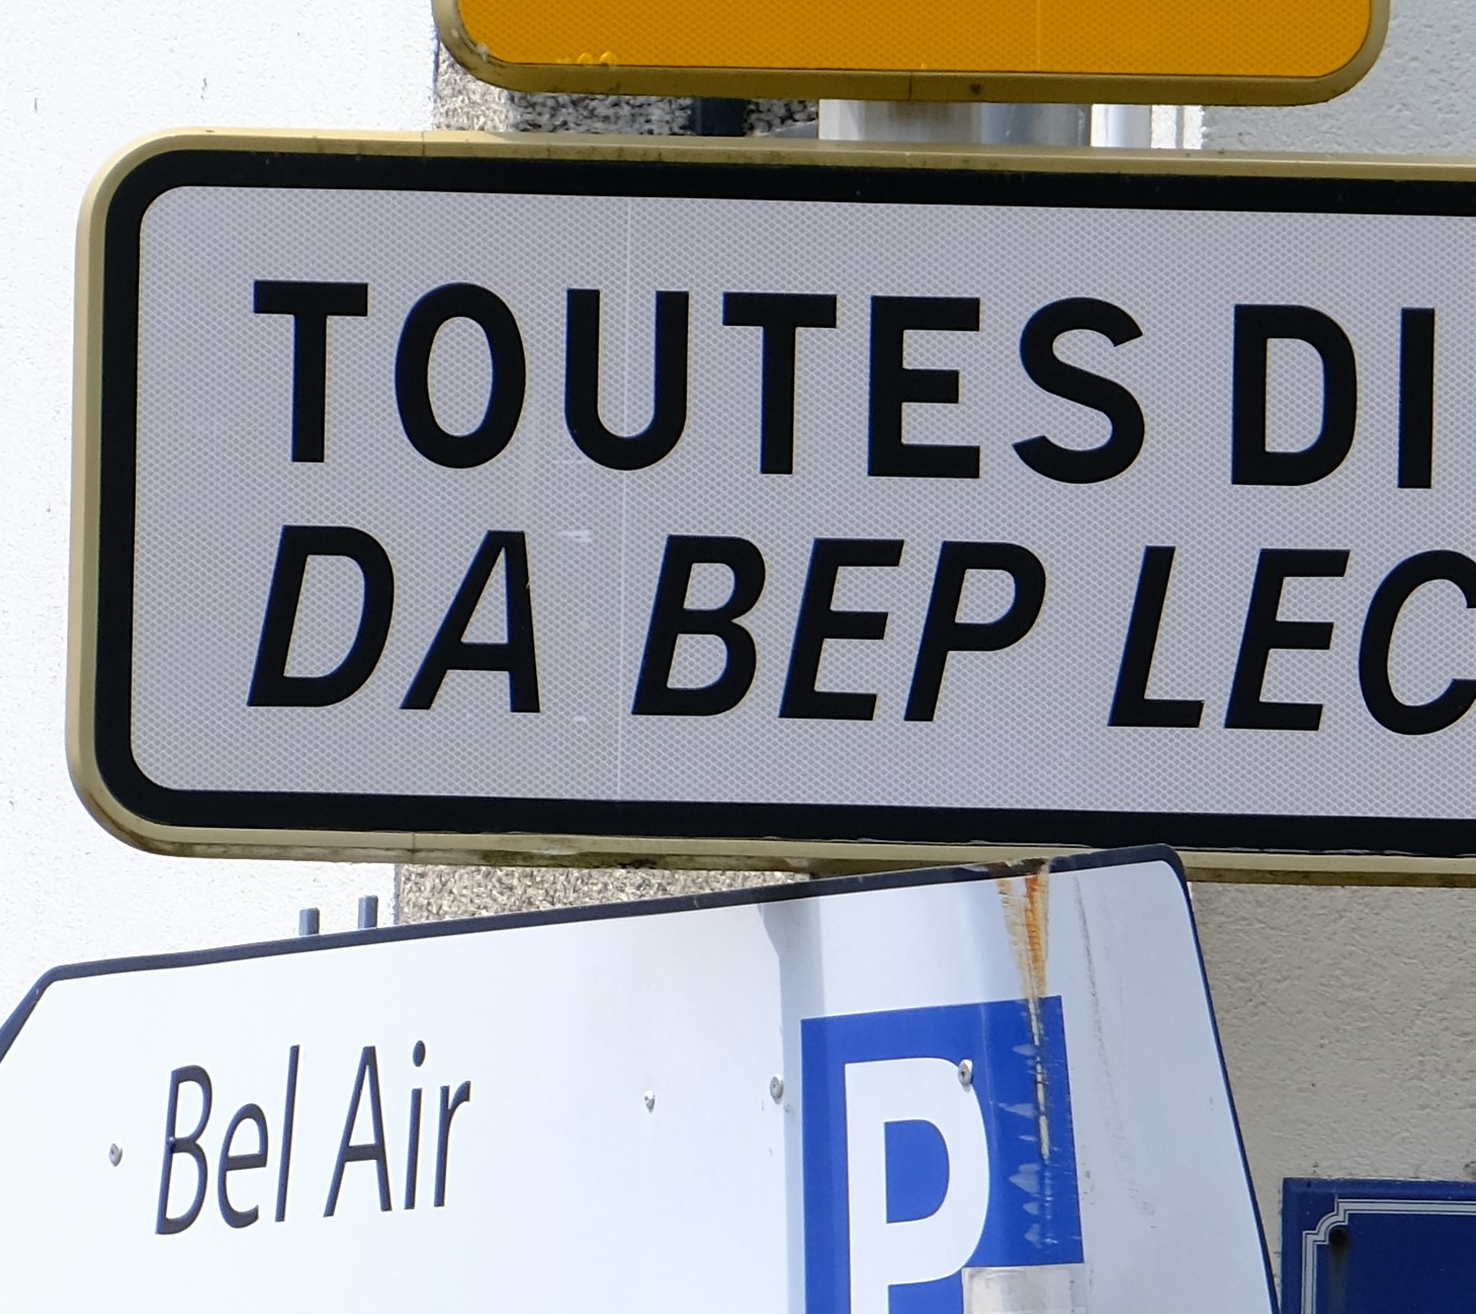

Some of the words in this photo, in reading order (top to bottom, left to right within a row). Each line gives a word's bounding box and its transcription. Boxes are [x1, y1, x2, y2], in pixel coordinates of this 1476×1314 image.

[252, 279, 1146, 485] TOUTES
[246, 523, 541, 714] DA
[630, 534, 1047, 723] BEP
[154, 1044, 301, 1236] Bel
[323, 1040, 472, 1218] Air
